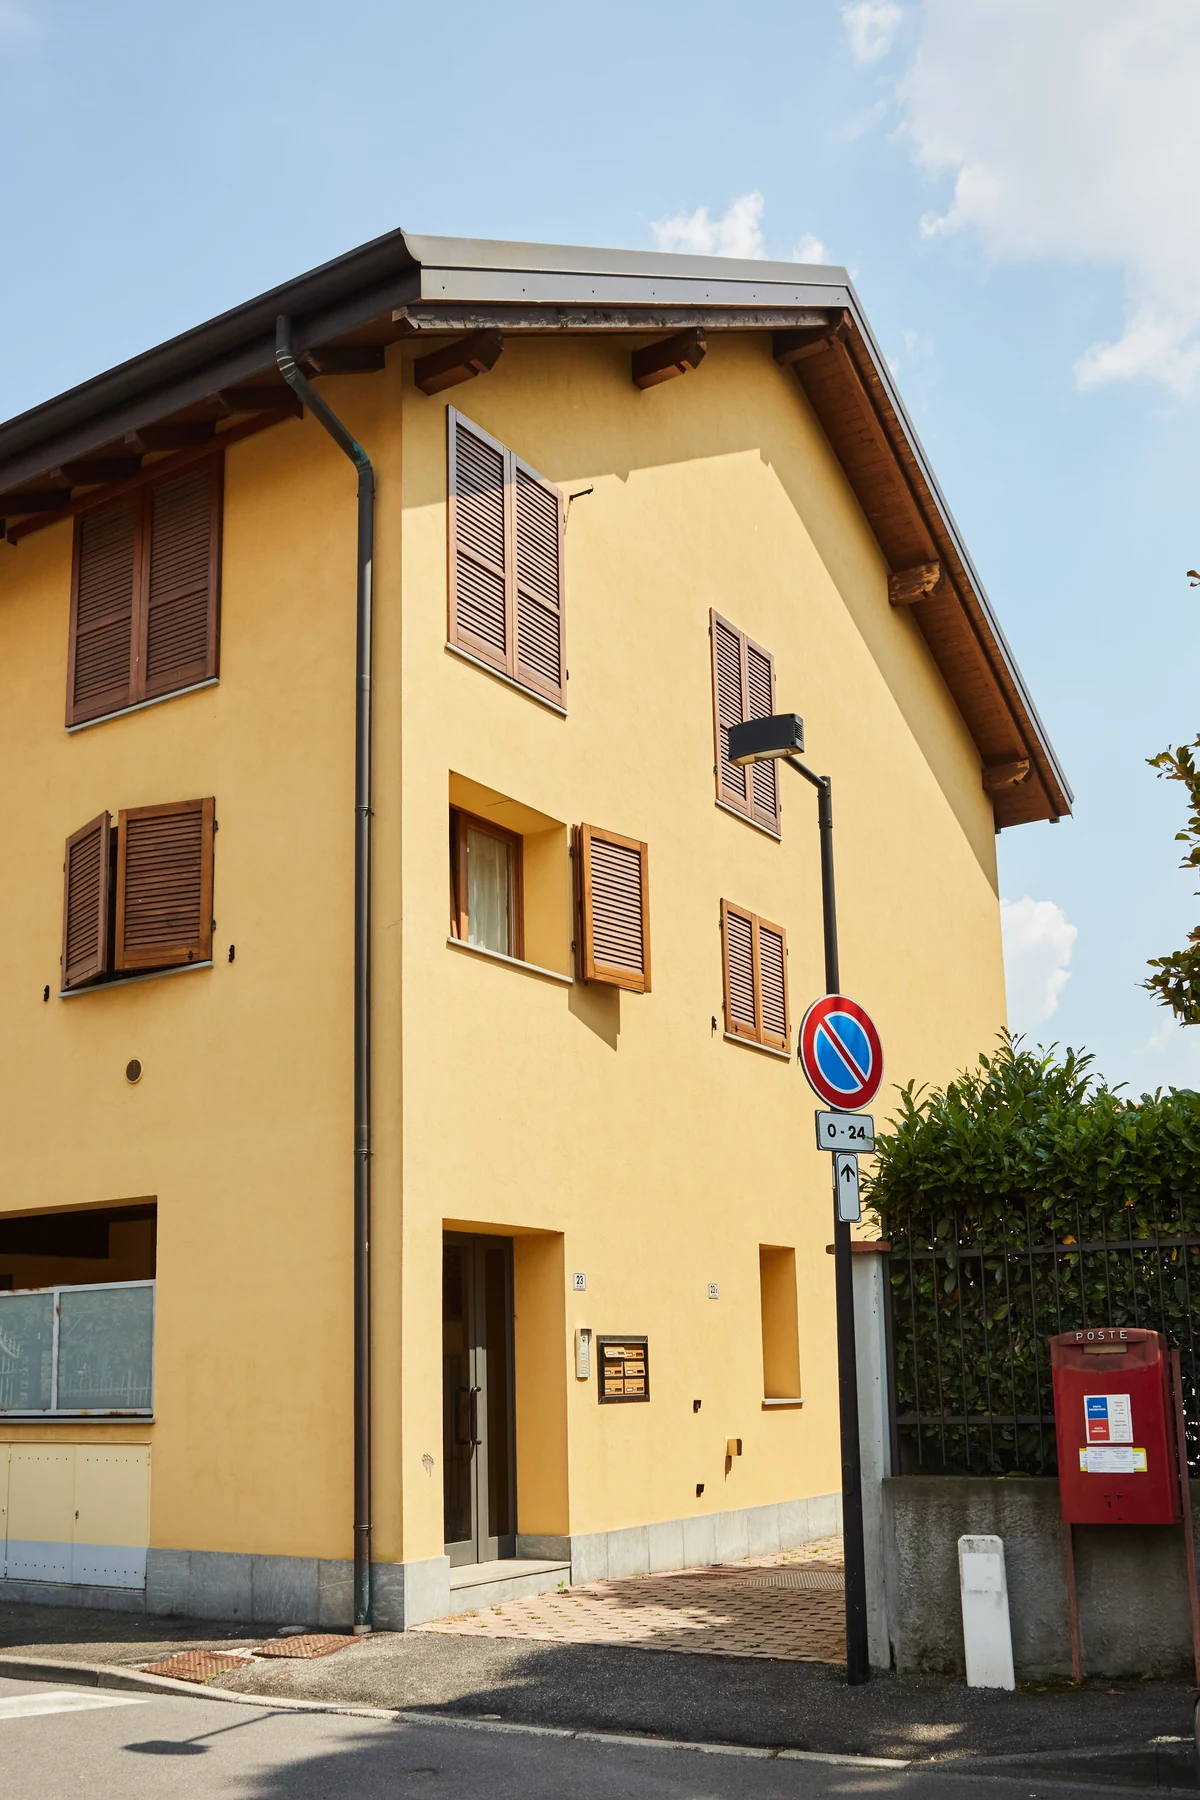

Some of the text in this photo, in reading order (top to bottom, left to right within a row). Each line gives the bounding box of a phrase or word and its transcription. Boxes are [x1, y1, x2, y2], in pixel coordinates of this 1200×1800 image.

[827, 1123, 836, 1138] 0
[848, 1125, 866, 1140] 24
[576, 1275, 584, 1285] 23
[1075, 1330, 1128, 1341] POSTE
